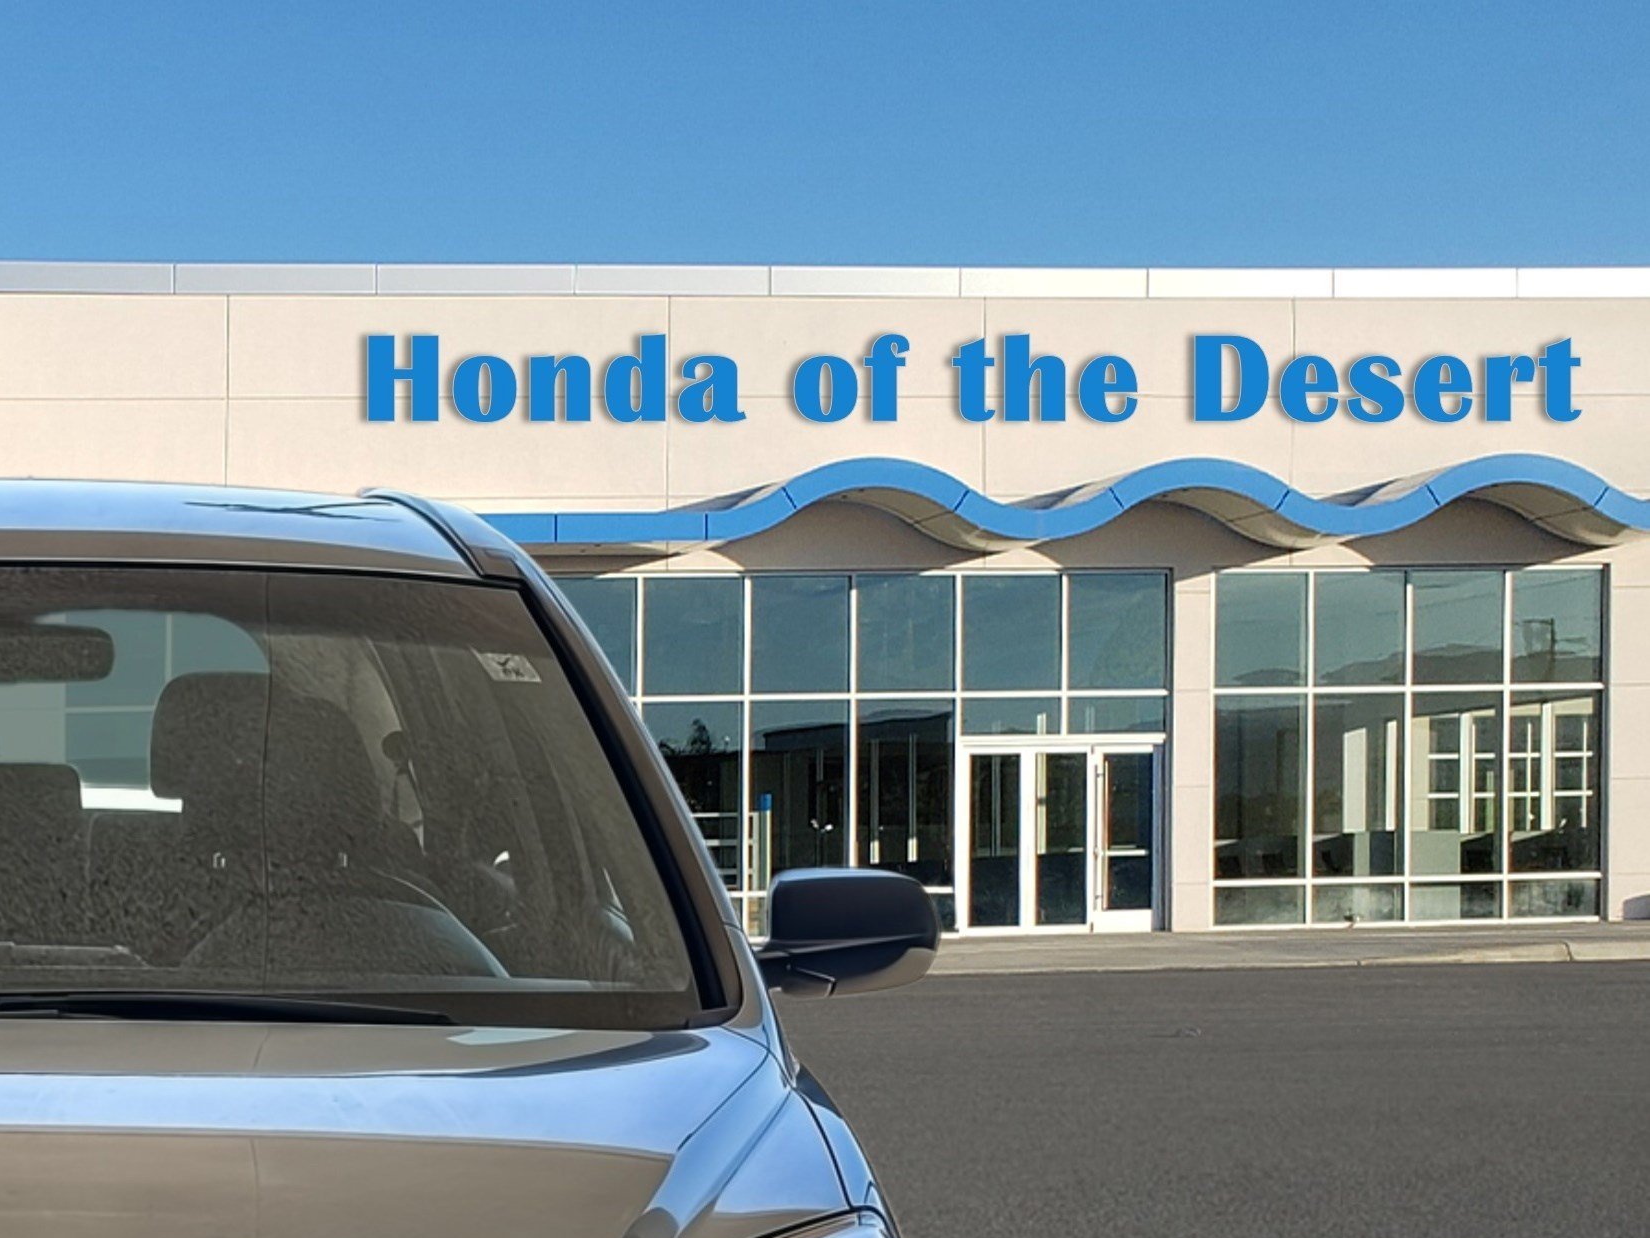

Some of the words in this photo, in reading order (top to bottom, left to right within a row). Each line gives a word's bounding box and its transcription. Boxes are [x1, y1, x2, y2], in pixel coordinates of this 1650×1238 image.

[366, 333, 747, 424] Honda
[792, 333, 911, 424] of
[951, 333, 1139, 424] the
[1193, 333, 1583, 424] Desert
